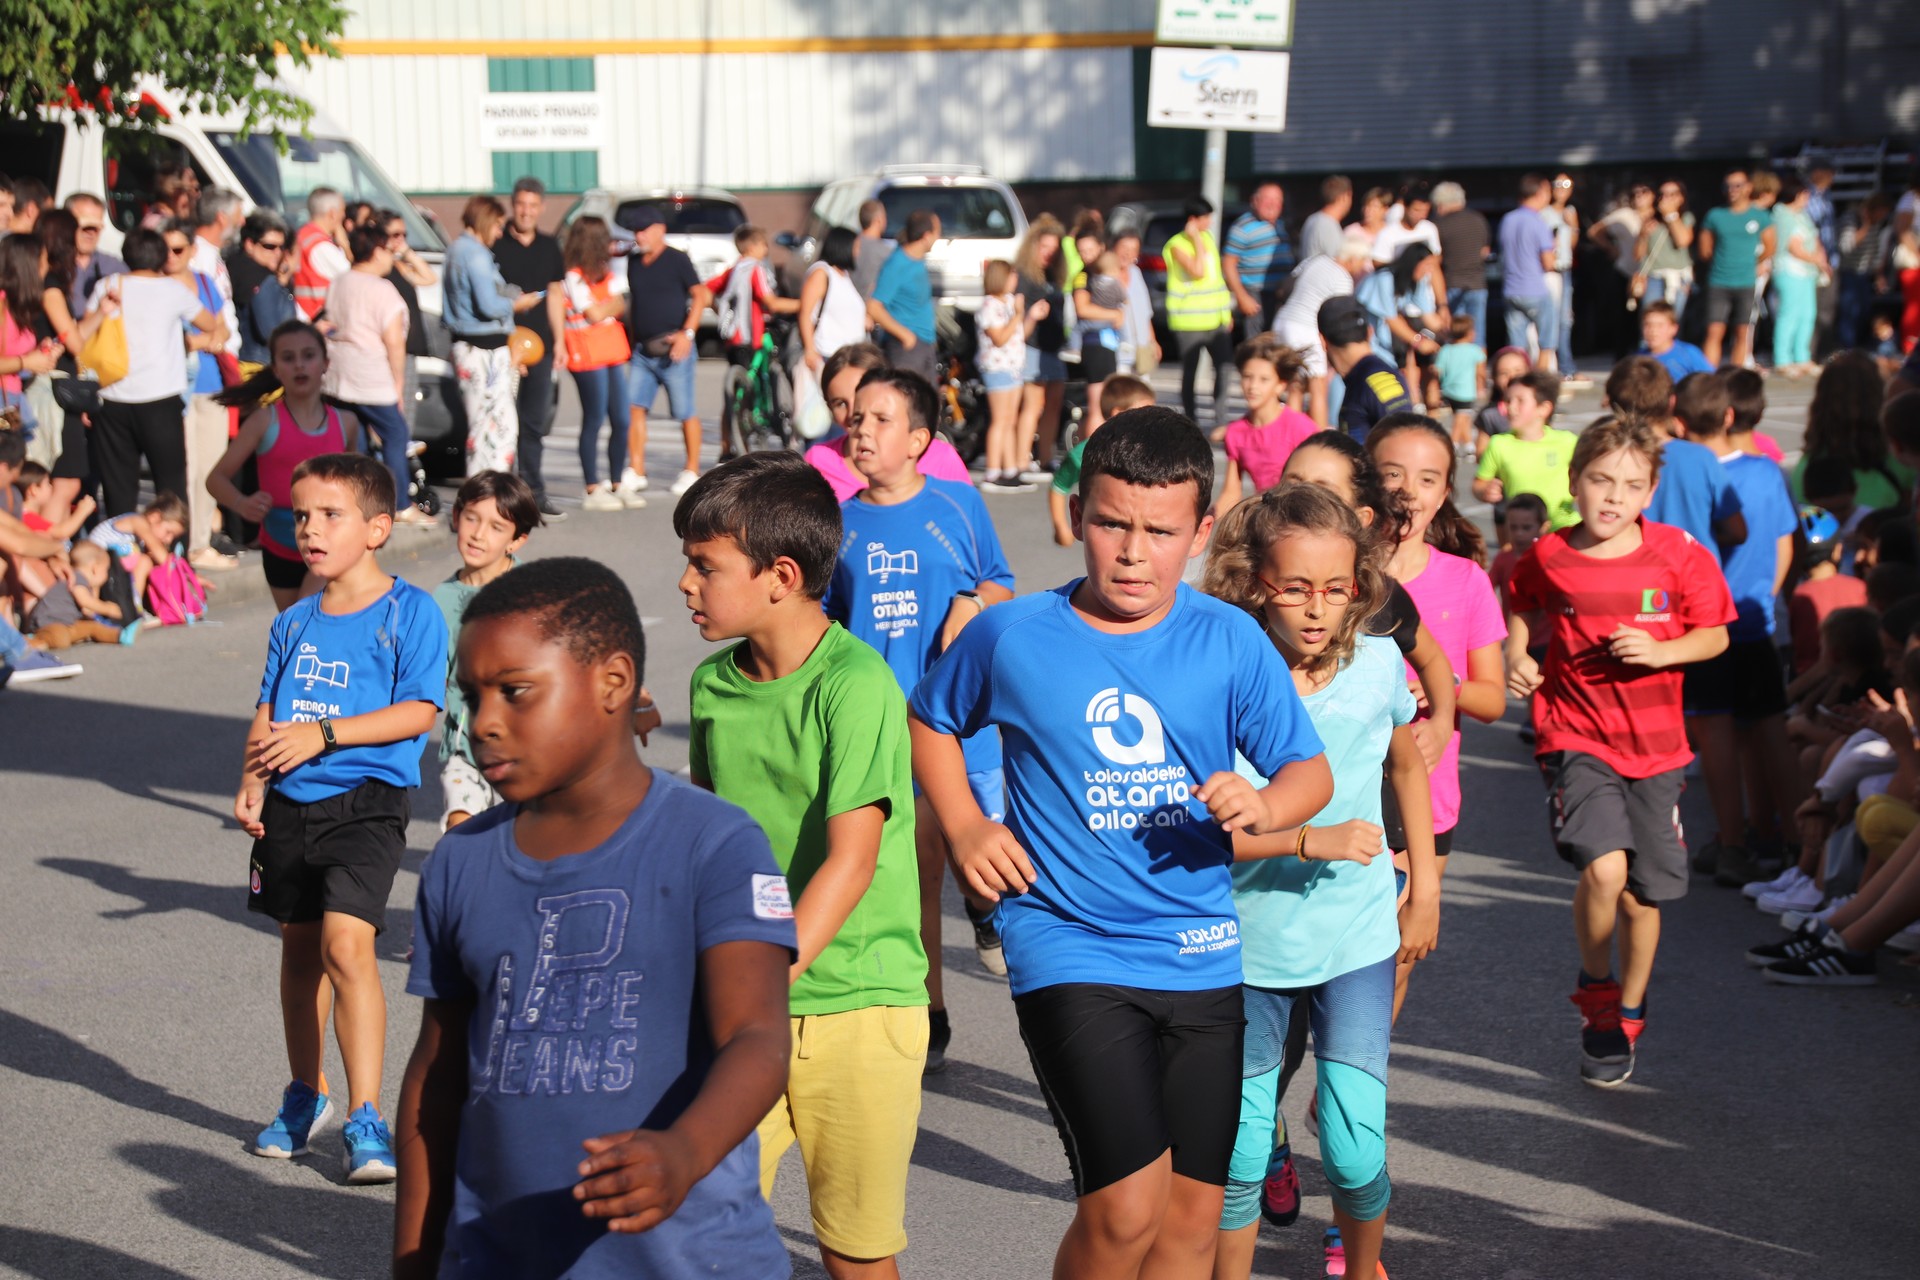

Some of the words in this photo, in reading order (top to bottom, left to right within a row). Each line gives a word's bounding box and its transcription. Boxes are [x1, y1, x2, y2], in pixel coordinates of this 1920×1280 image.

[1198, 78, 1259, 105] Stern
[484, 103, 540, 118] PARKING
[544, 102, 600, 117] PRIVADO
[873, 598, 919, 619] OTAÑO
[292, 699, 327, 713] PEDRO
[328, 704, 342, 716] M.
[291, 712, 328, 723] OTA
[1083, 765, 1186, 784] tolosaldeko
[1086, 780, 1190, 808] ataria
[1088, 806, 1190, 833] pilotan!
[1178, 946, 1206, 956] pilota
